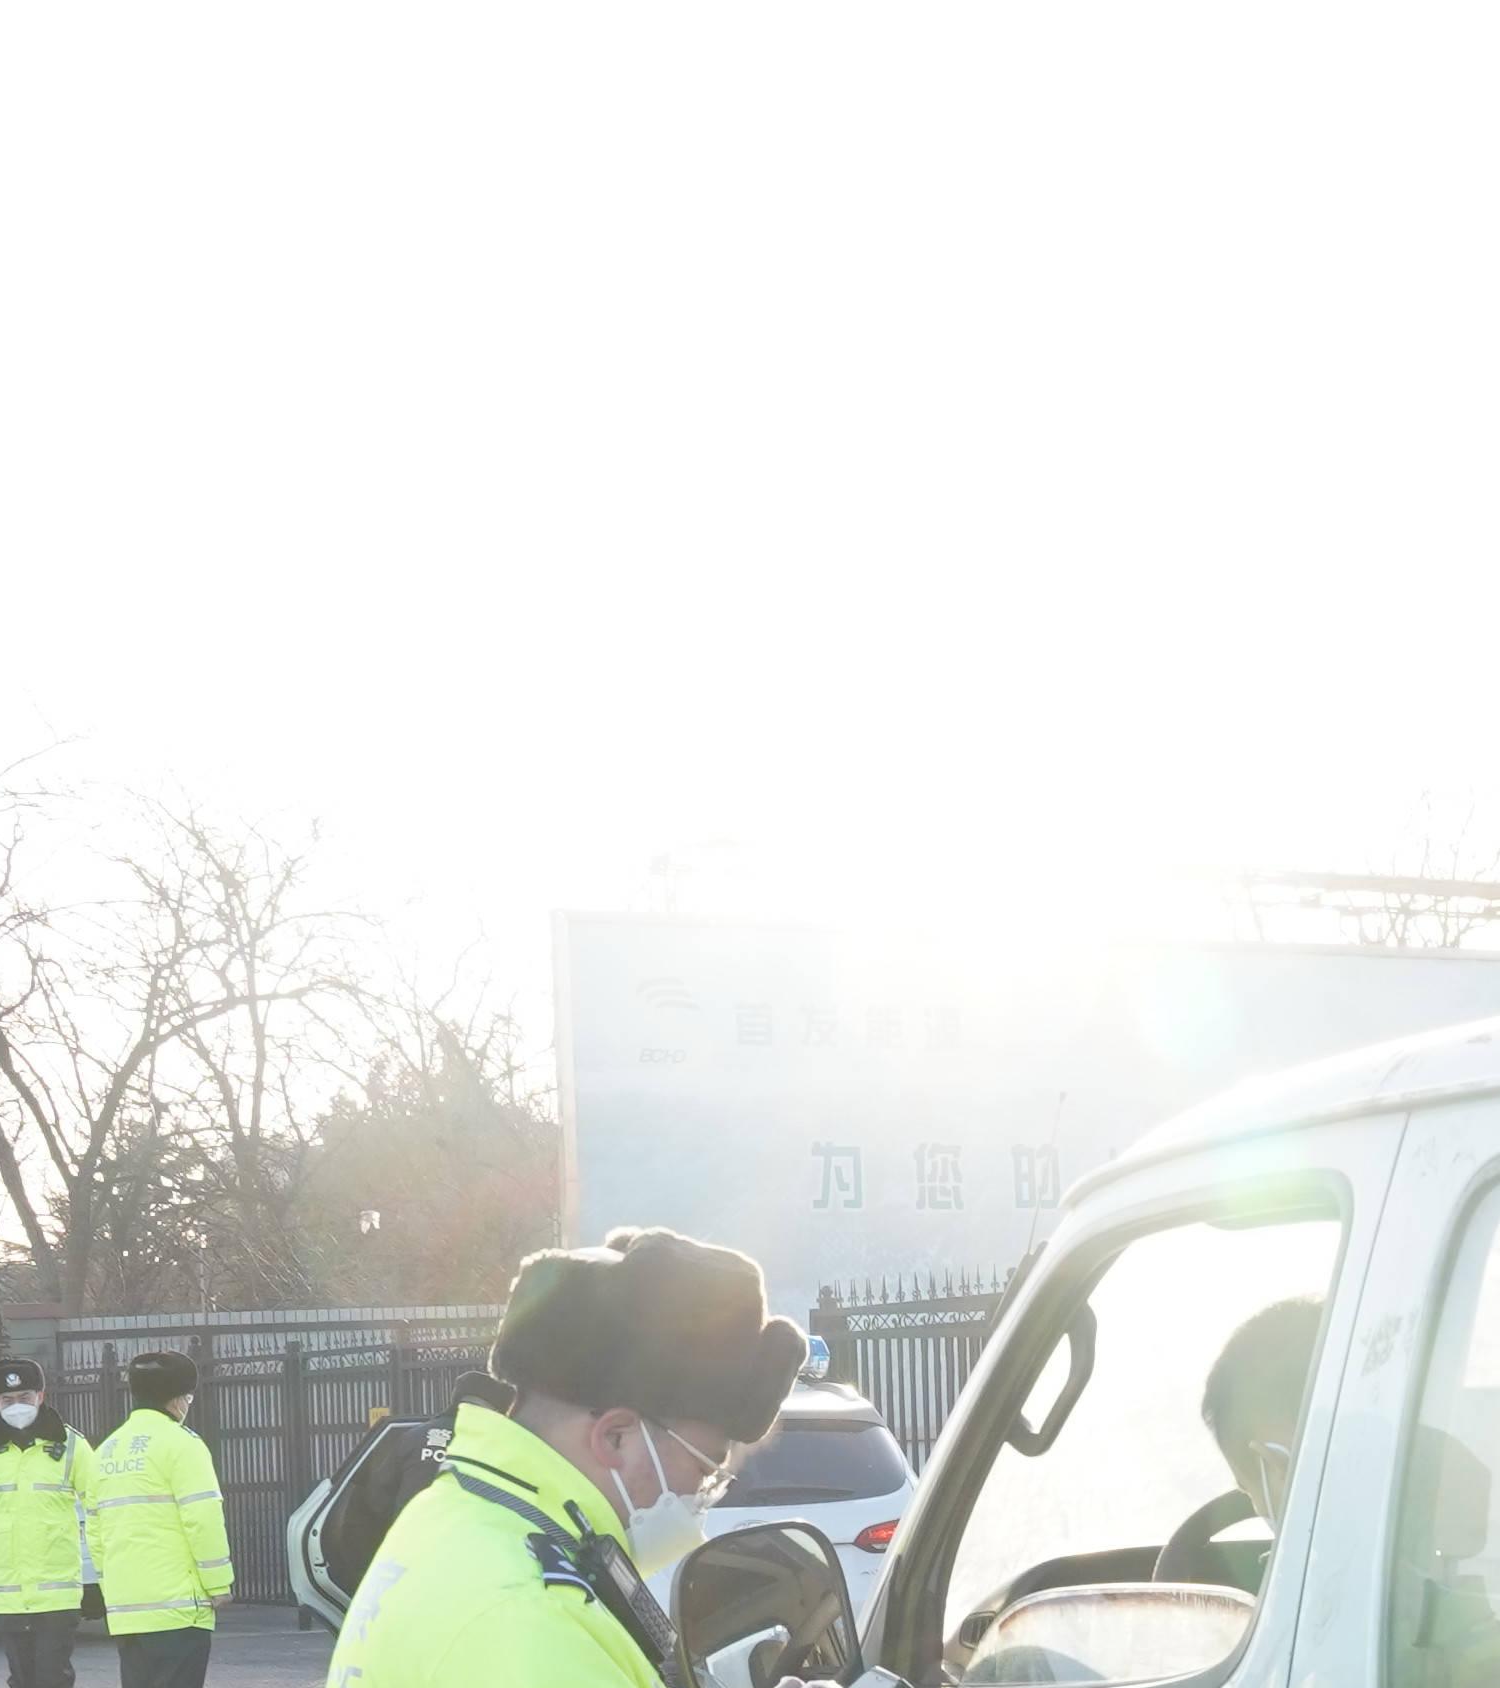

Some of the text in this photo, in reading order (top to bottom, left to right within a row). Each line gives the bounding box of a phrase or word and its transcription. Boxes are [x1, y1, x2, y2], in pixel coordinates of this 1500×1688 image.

[810, 1139, 1116, 1210] 为您的
[99, 1457, 146, 1475] POLICE
